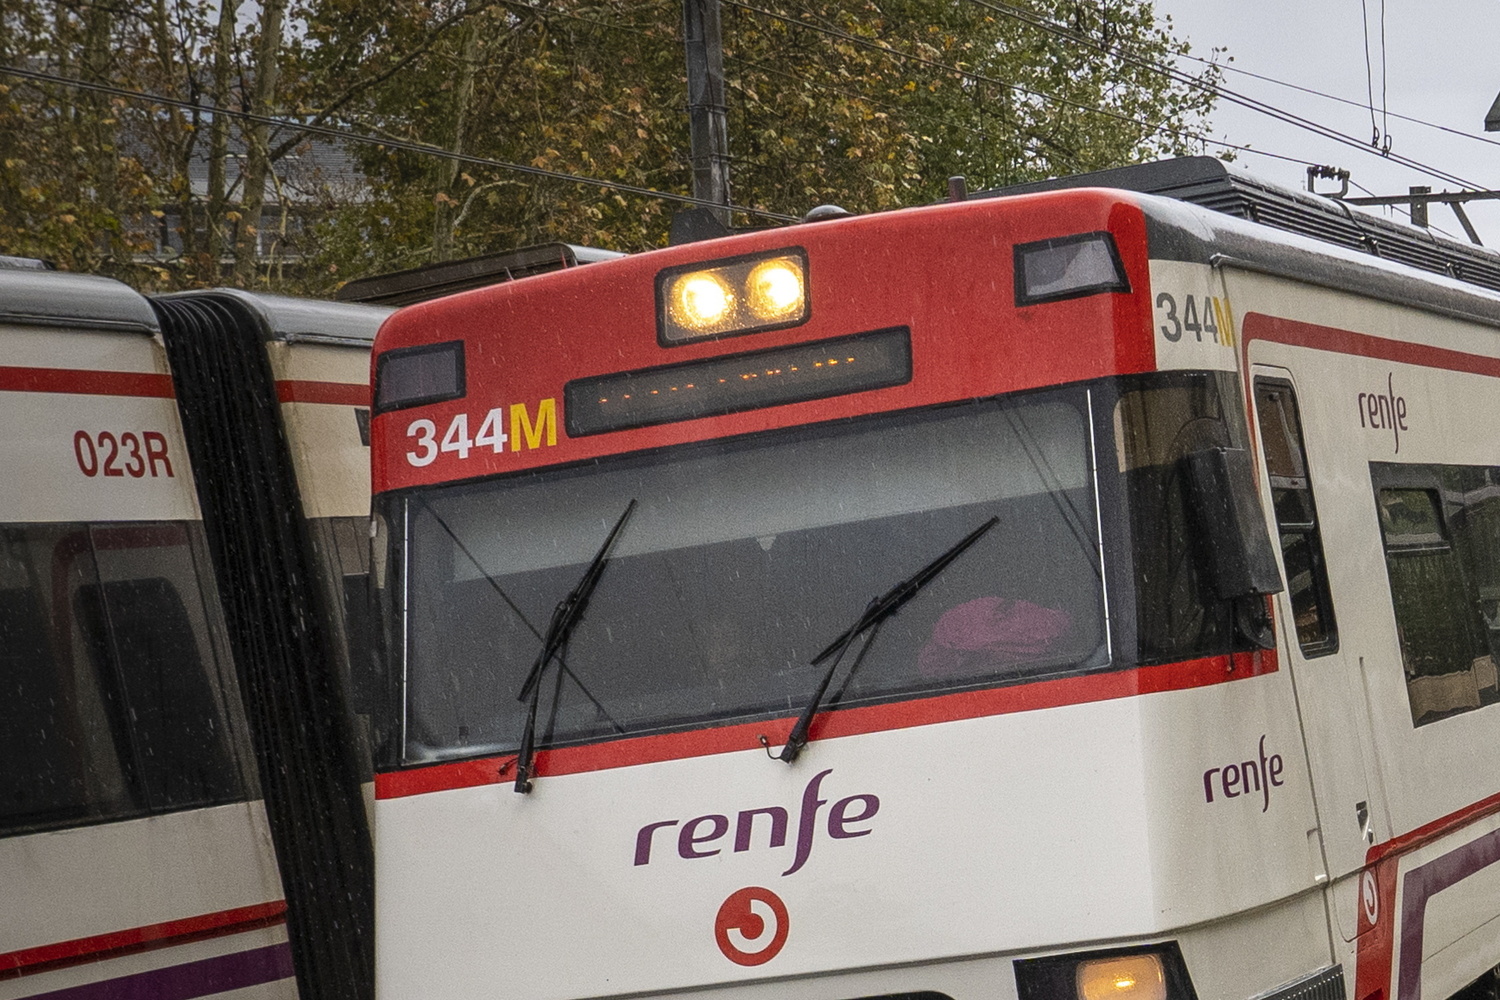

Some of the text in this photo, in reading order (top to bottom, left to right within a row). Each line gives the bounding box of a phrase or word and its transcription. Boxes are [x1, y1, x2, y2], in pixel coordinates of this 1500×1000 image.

[1155, 292, 1235, 348] 344M
[406, 398, 558, 469] 344M
[1357, 371, 1409, 454] renfe
[73, 429, 174, 480] 023R
[1203, 733, 1285, 813] renfe
[632, 768, 882, 878] renfe
